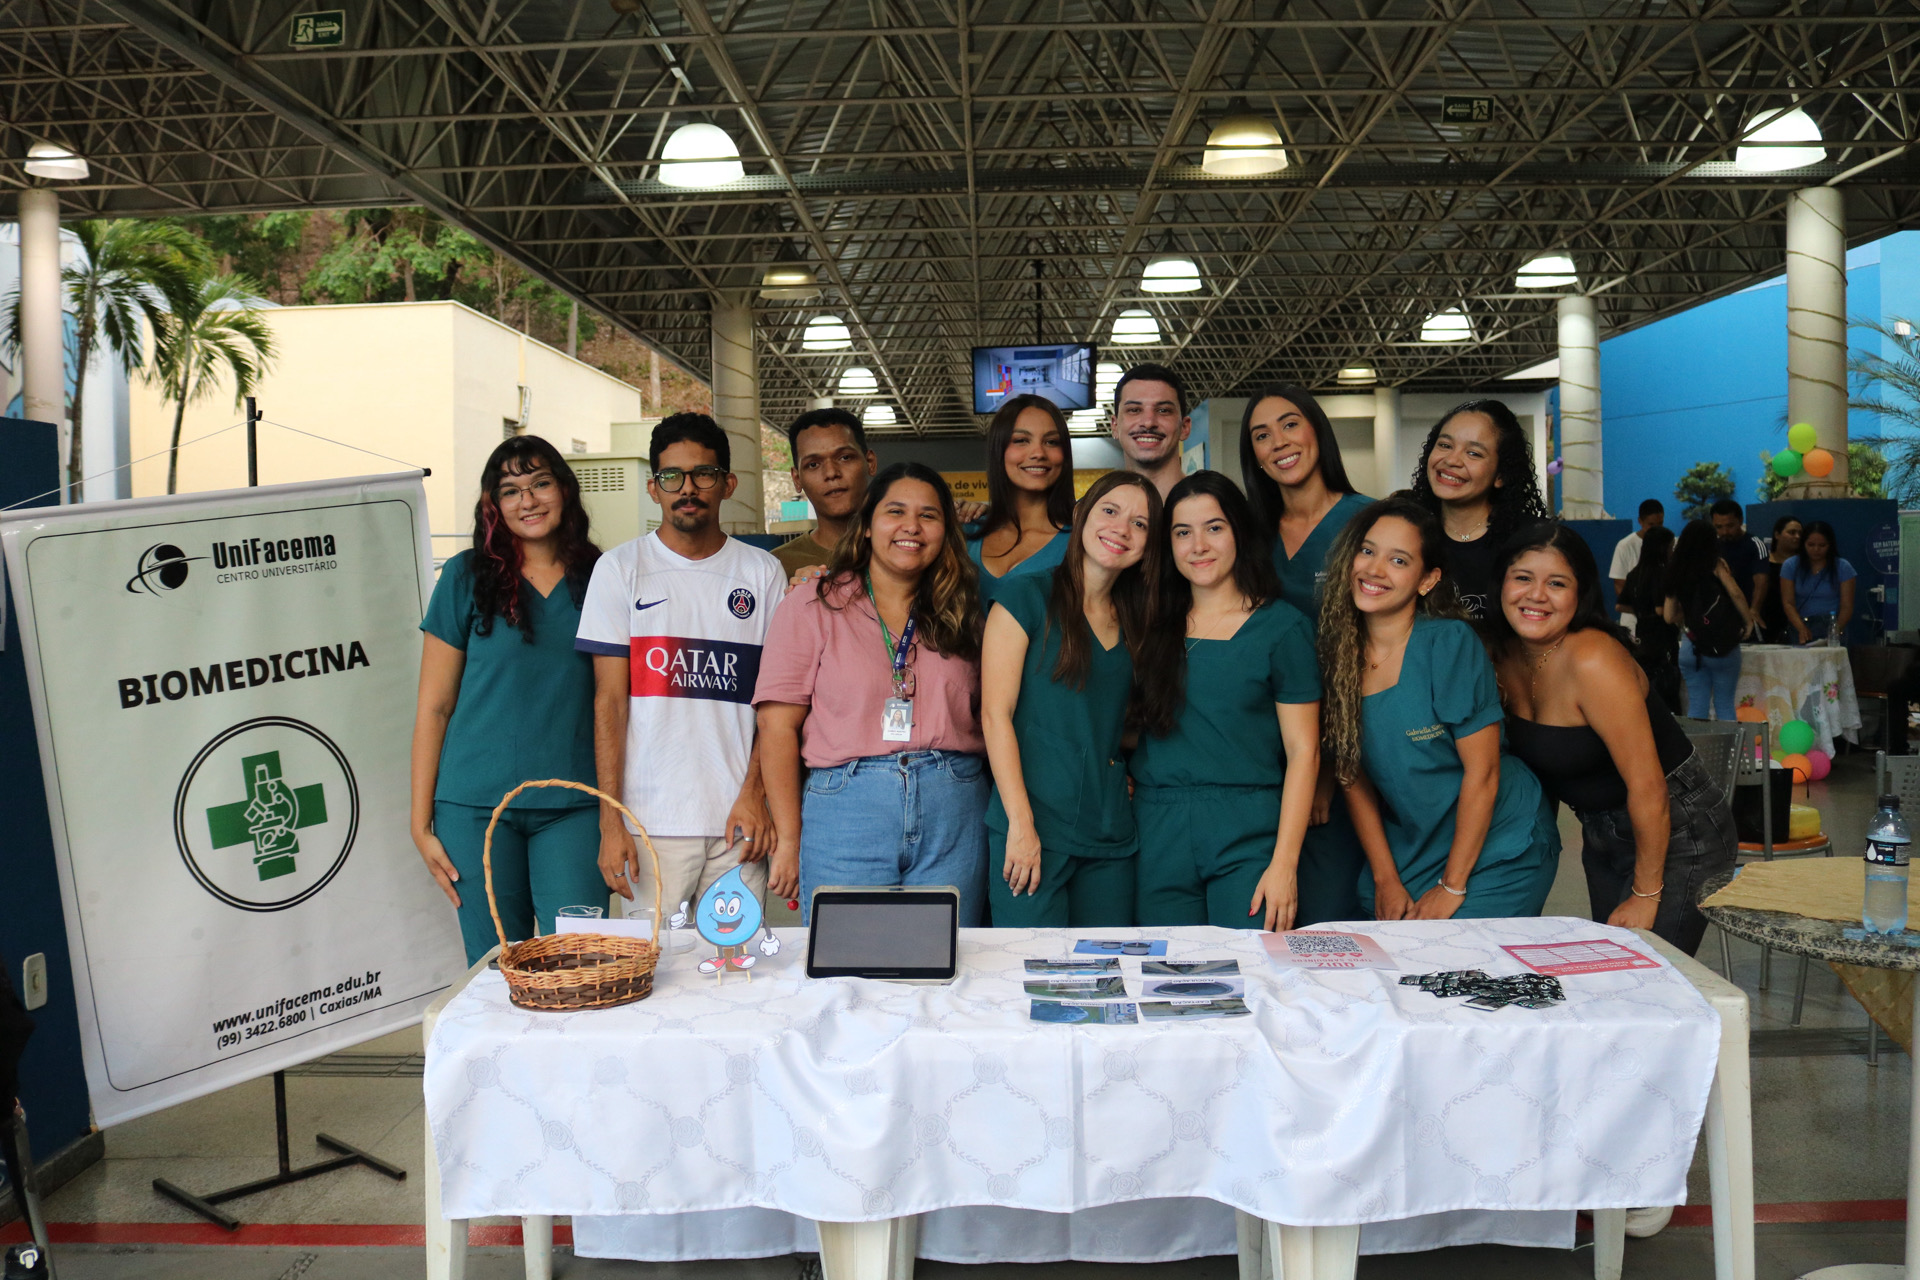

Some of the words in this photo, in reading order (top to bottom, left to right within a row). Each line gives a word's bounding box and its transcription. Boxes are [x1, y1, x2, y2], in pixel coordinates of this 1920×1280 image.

[954, 480, 969, 490] de
[212, 534, 336, 569] UniFacema
[216, 570, 259, 584] CENTRO
[262, 560, 337, 579] UNIVERSITÁRIO
[732, 589, 752, 599] PARIS
[118, 640, 370, 709] BIOMEDICINA
[645, 646, 738, 677] QATAR
[670, 673, 738, 692] AIRWAYS
[212, 971, 381, 1034] www.unifacema.edu.br
[217, 1031, 242, 1051] (99)
[245, 1009, 307, 1040] 3422.6800
[319, 986, 382, 1015] Caxias/MA
